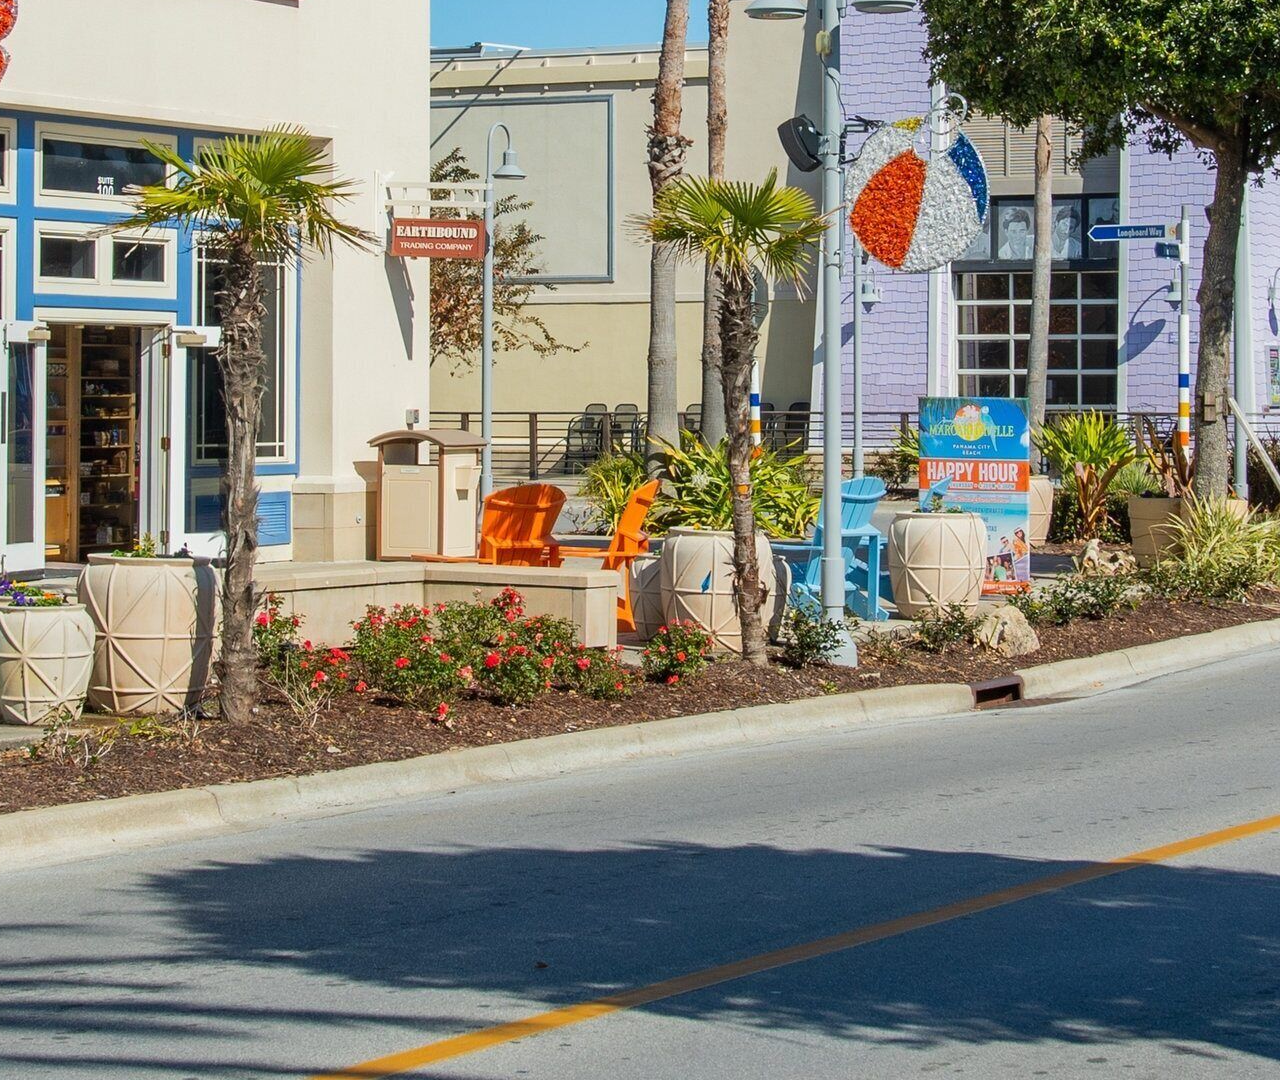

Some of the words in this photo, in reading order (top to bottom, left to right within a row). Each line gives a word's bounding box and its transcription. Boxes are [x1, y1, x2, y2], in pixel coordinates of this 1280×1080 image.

[97, 176, 115, 185] SUITE
[97, 184, 115, 196] 100
[396, 226, 477, 239] EARTHBOUND
[1117, 227, 1149, 238] Longboard
[1149, 227, 1163, 237] Way
[400, 241, 434, 250] TRADING
[435, 243, 473, 251] COMPANY
[927, 461, 974, 481] HAPPY
[978, 462, 1018, 482] HOUR
